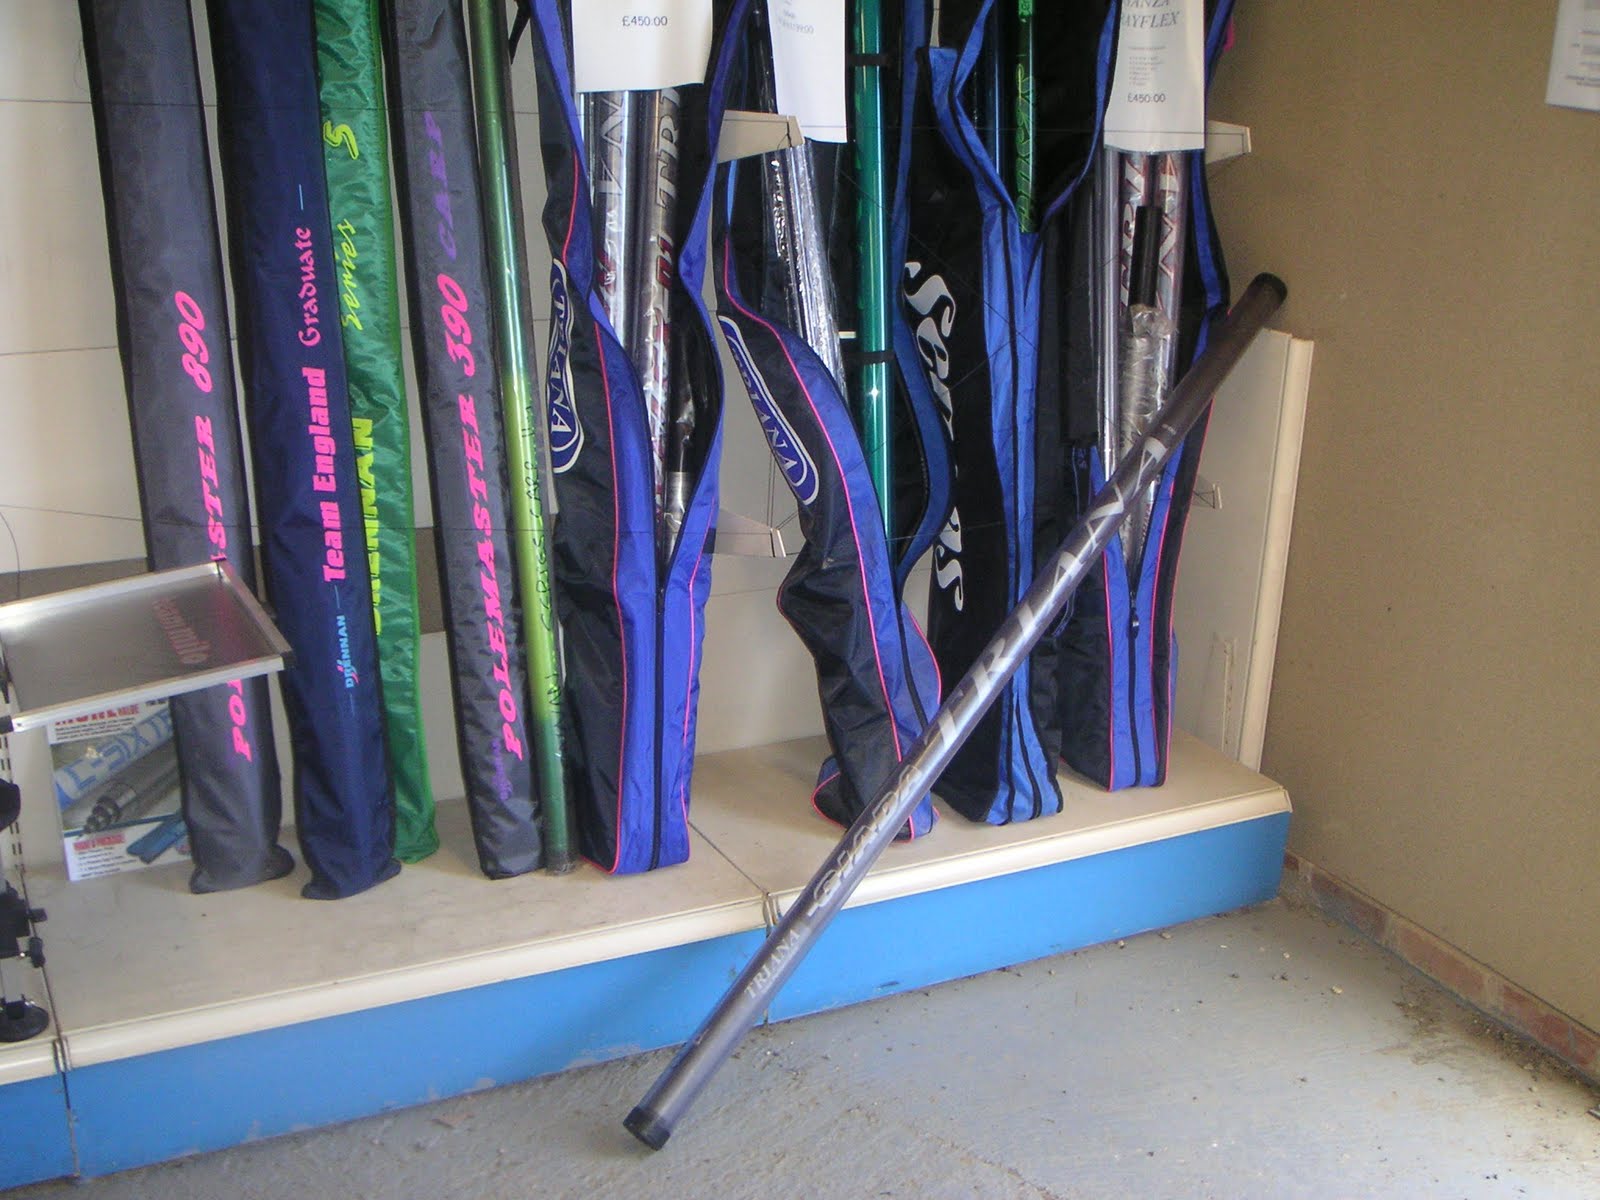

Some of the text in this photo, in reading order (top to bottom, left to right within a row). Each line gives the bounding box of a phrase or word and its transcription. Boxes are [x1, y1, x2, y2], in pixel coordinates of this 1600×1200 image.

[622, 15, 668, 27] £450.00
[322, 119, 361, 160] 5
[1127, 93, 1166, 103] £450.00
[422, 111, 457, 260] CARP
[174, 290, 214, 394] 890
[436, 274, 476, 377] 390
[294, 227, 346, 583] Team England Graduate
[457, 394, 524, 762] POLEMASTER
[924, 437, 1168, 749] TRIANA
[743, 928, 802, 999] TRIANA
